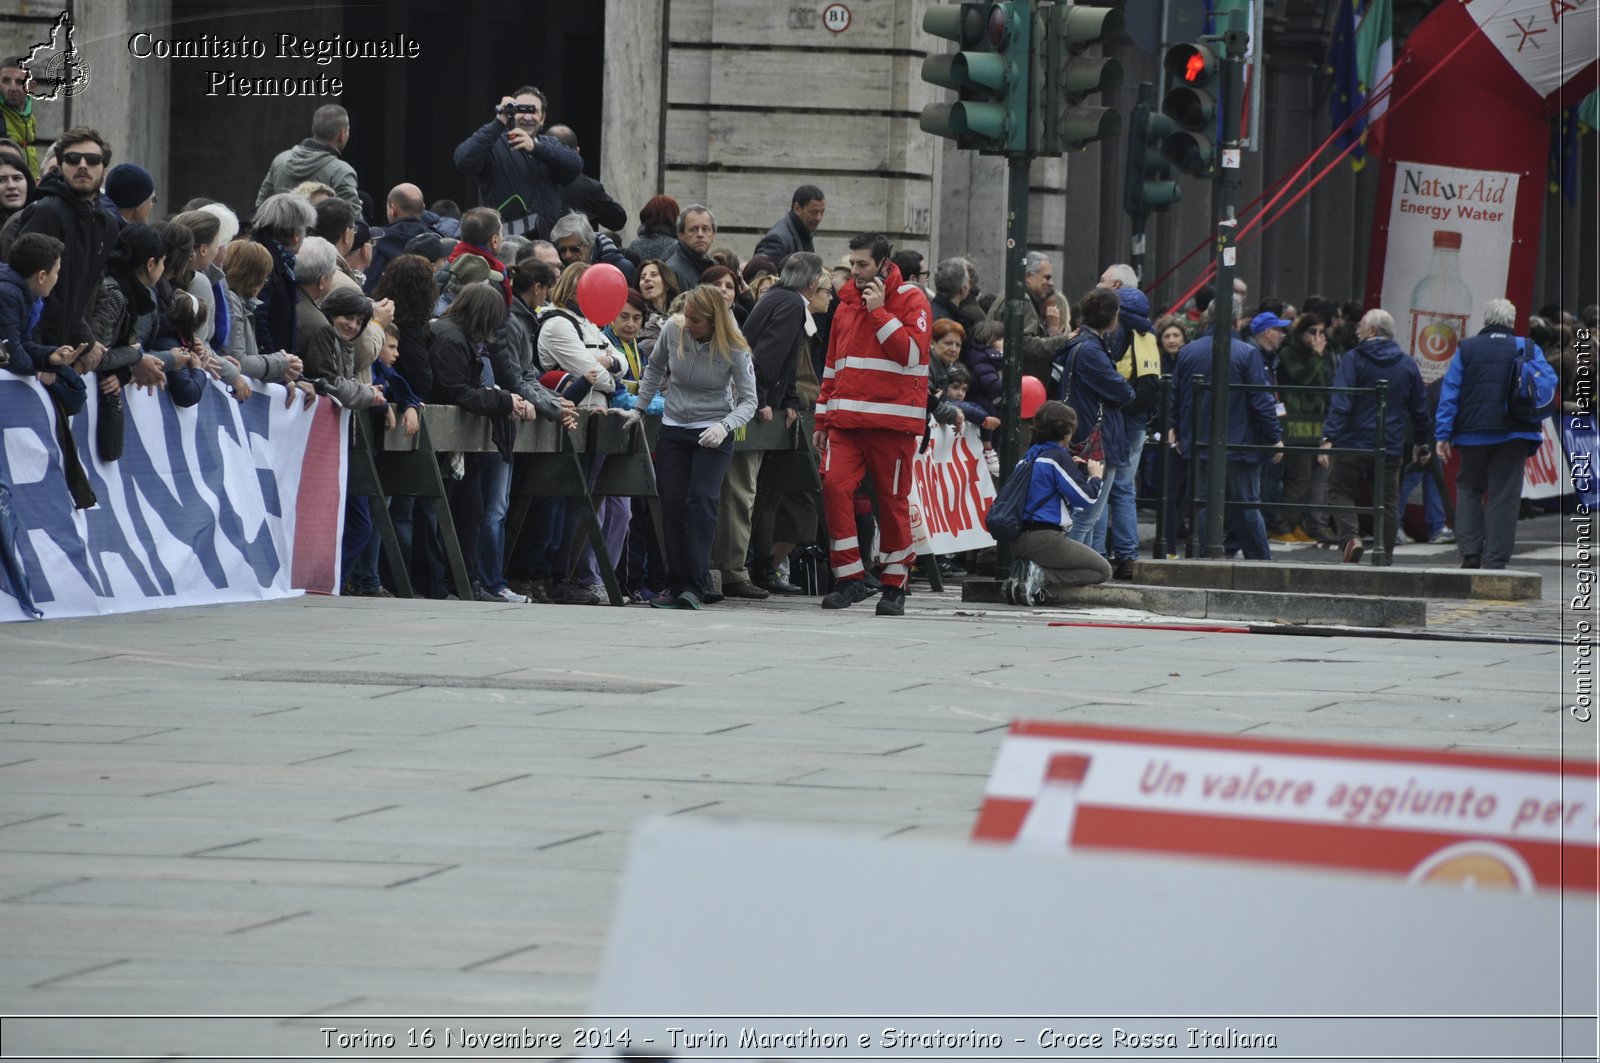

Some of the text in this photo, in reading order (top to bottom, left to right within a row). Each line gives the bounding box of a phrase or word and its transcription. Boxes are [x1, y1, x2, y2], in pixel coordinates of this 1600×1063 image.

[1403, 169, 1508, 204] NaturAid
[1400, 199, 1504, 222] Energy Water
[1139, 760, 1584, 832] Un valore aggiunto per
